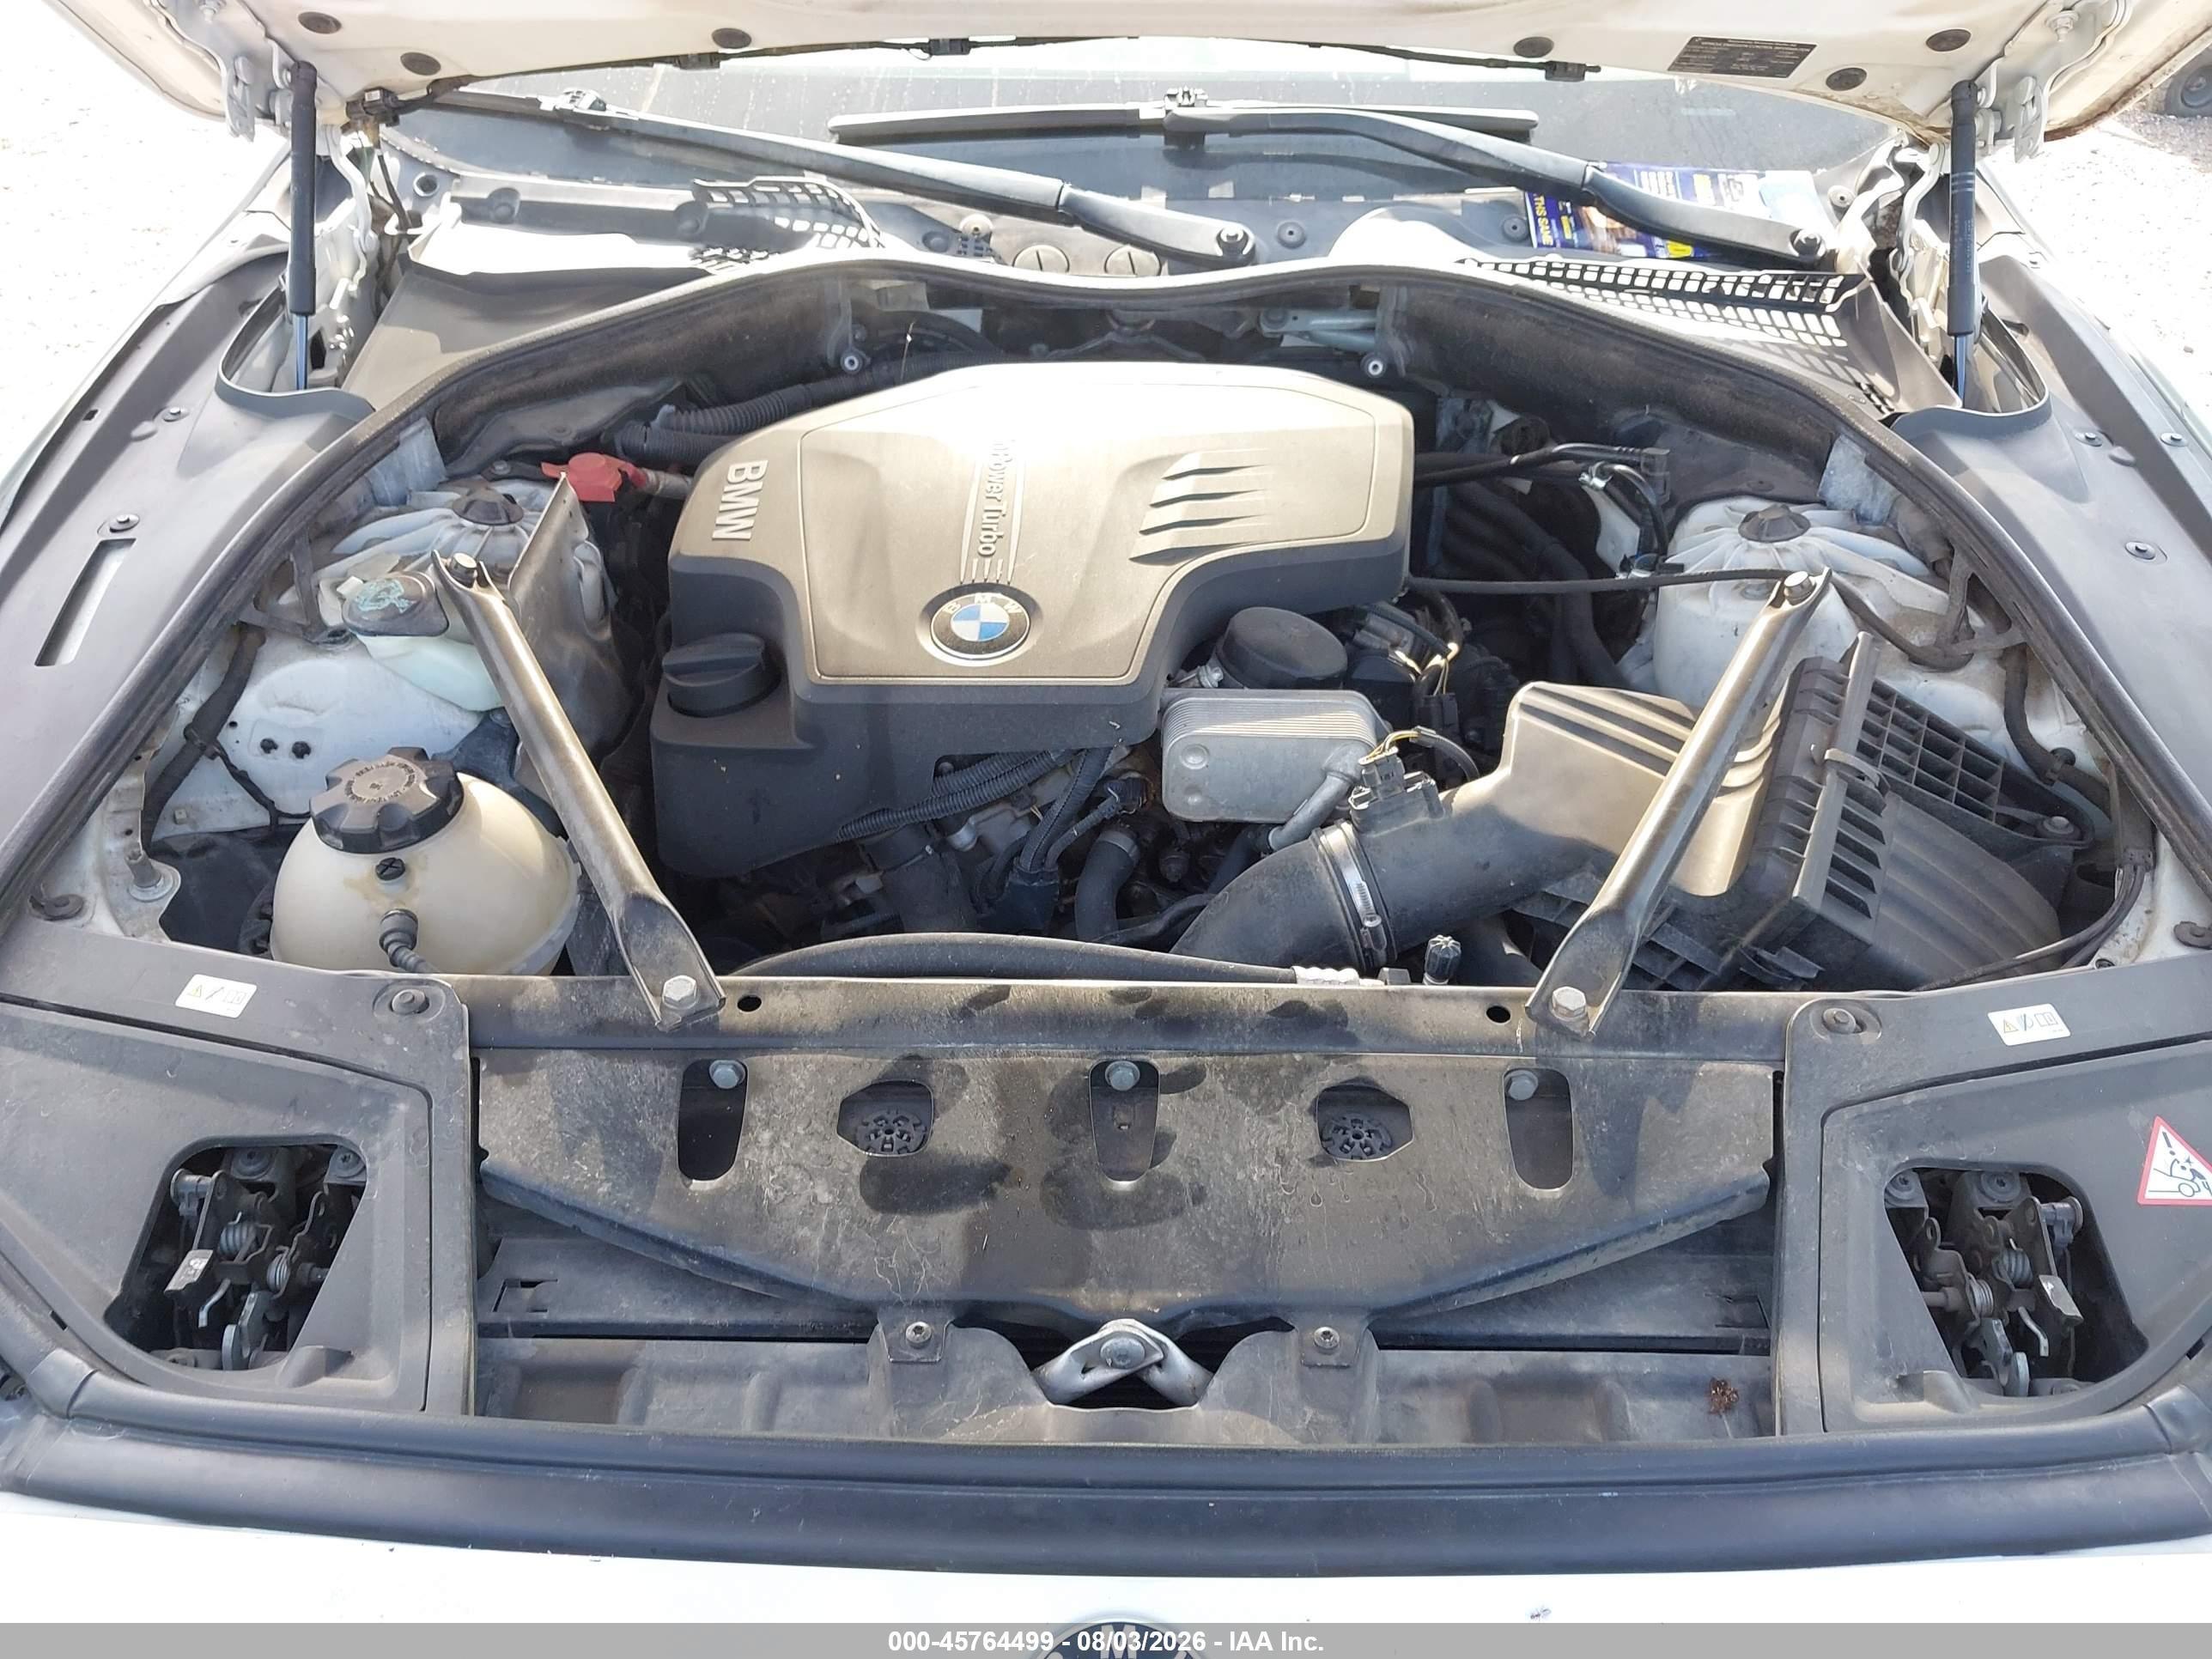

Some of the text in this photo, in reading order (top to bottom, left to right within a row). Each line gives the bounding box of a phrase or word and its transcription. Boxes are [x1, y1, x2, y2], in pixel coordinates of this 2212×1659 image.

[712, 460, 769, 541] BMW
[977, 501, 1006, 557] Turbo
[942, 592, 1022, 615] BMW
